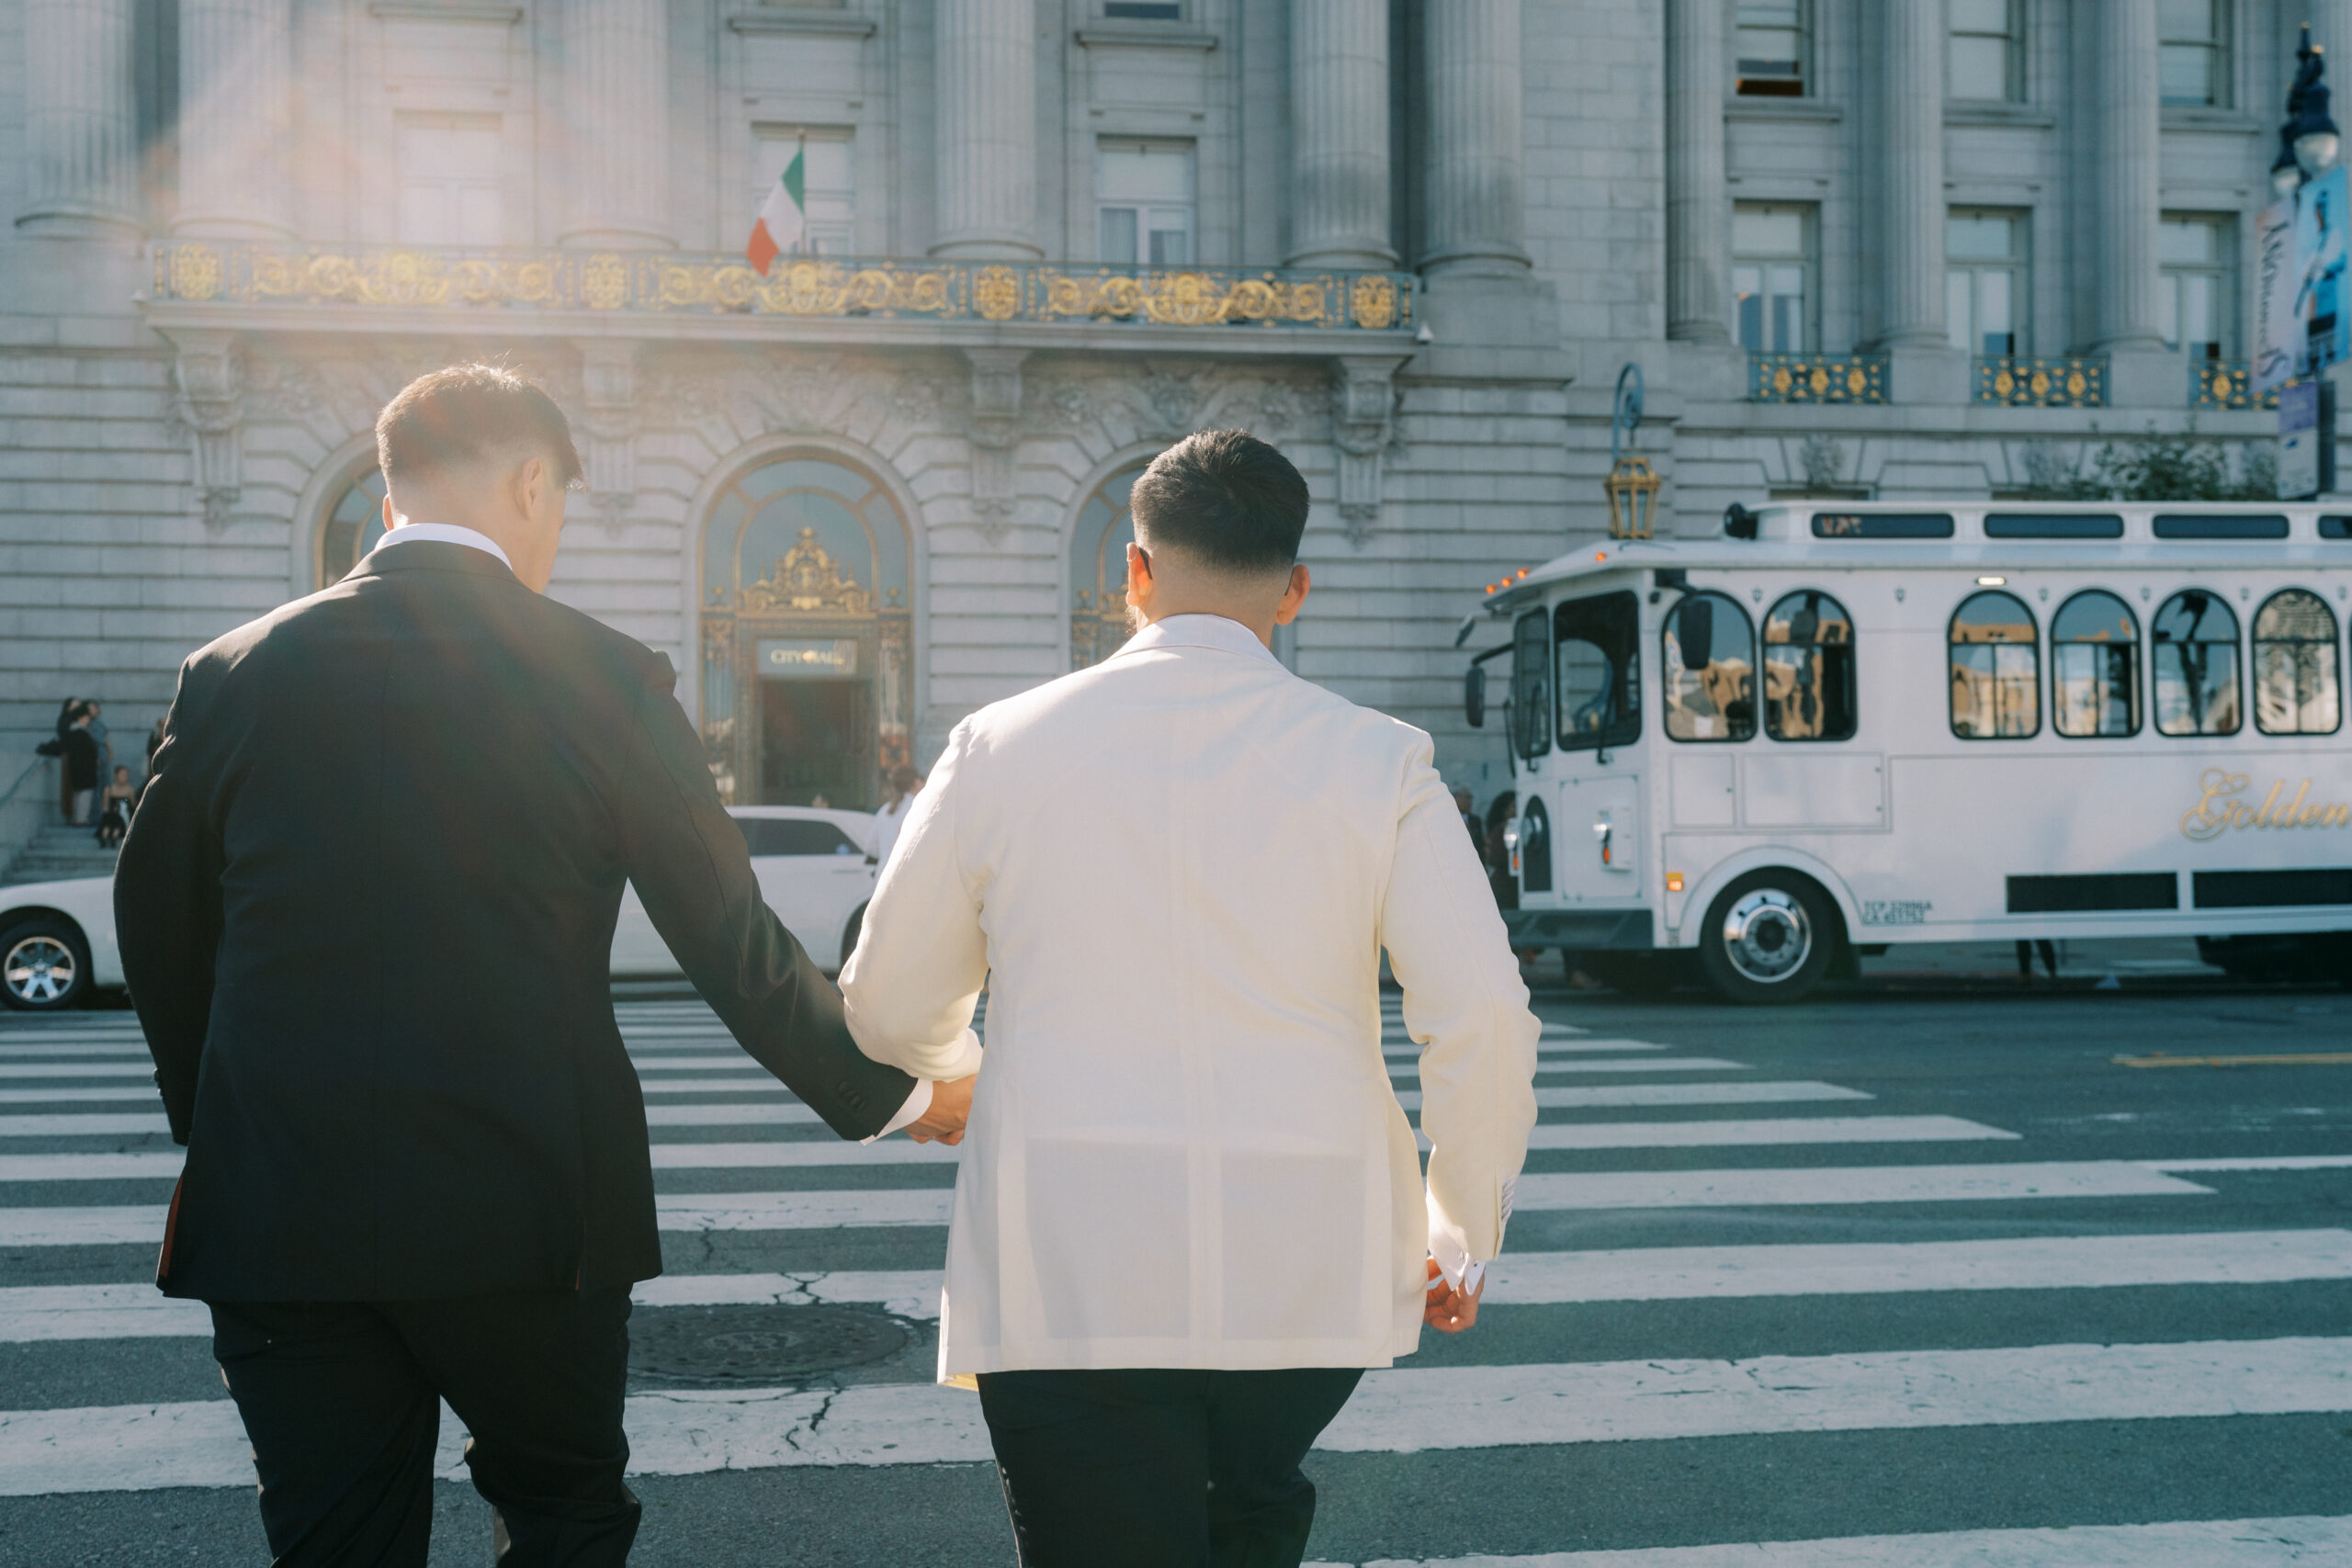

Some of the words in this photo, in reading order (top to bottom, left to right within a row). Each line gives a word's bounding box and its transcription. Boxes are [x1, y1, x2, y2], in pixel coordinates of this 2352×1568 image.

[770, 649, 802, 664] CITY
[2179, 768, 2352, 842] Golden
[1863, 900, 1885, 913] TCP
